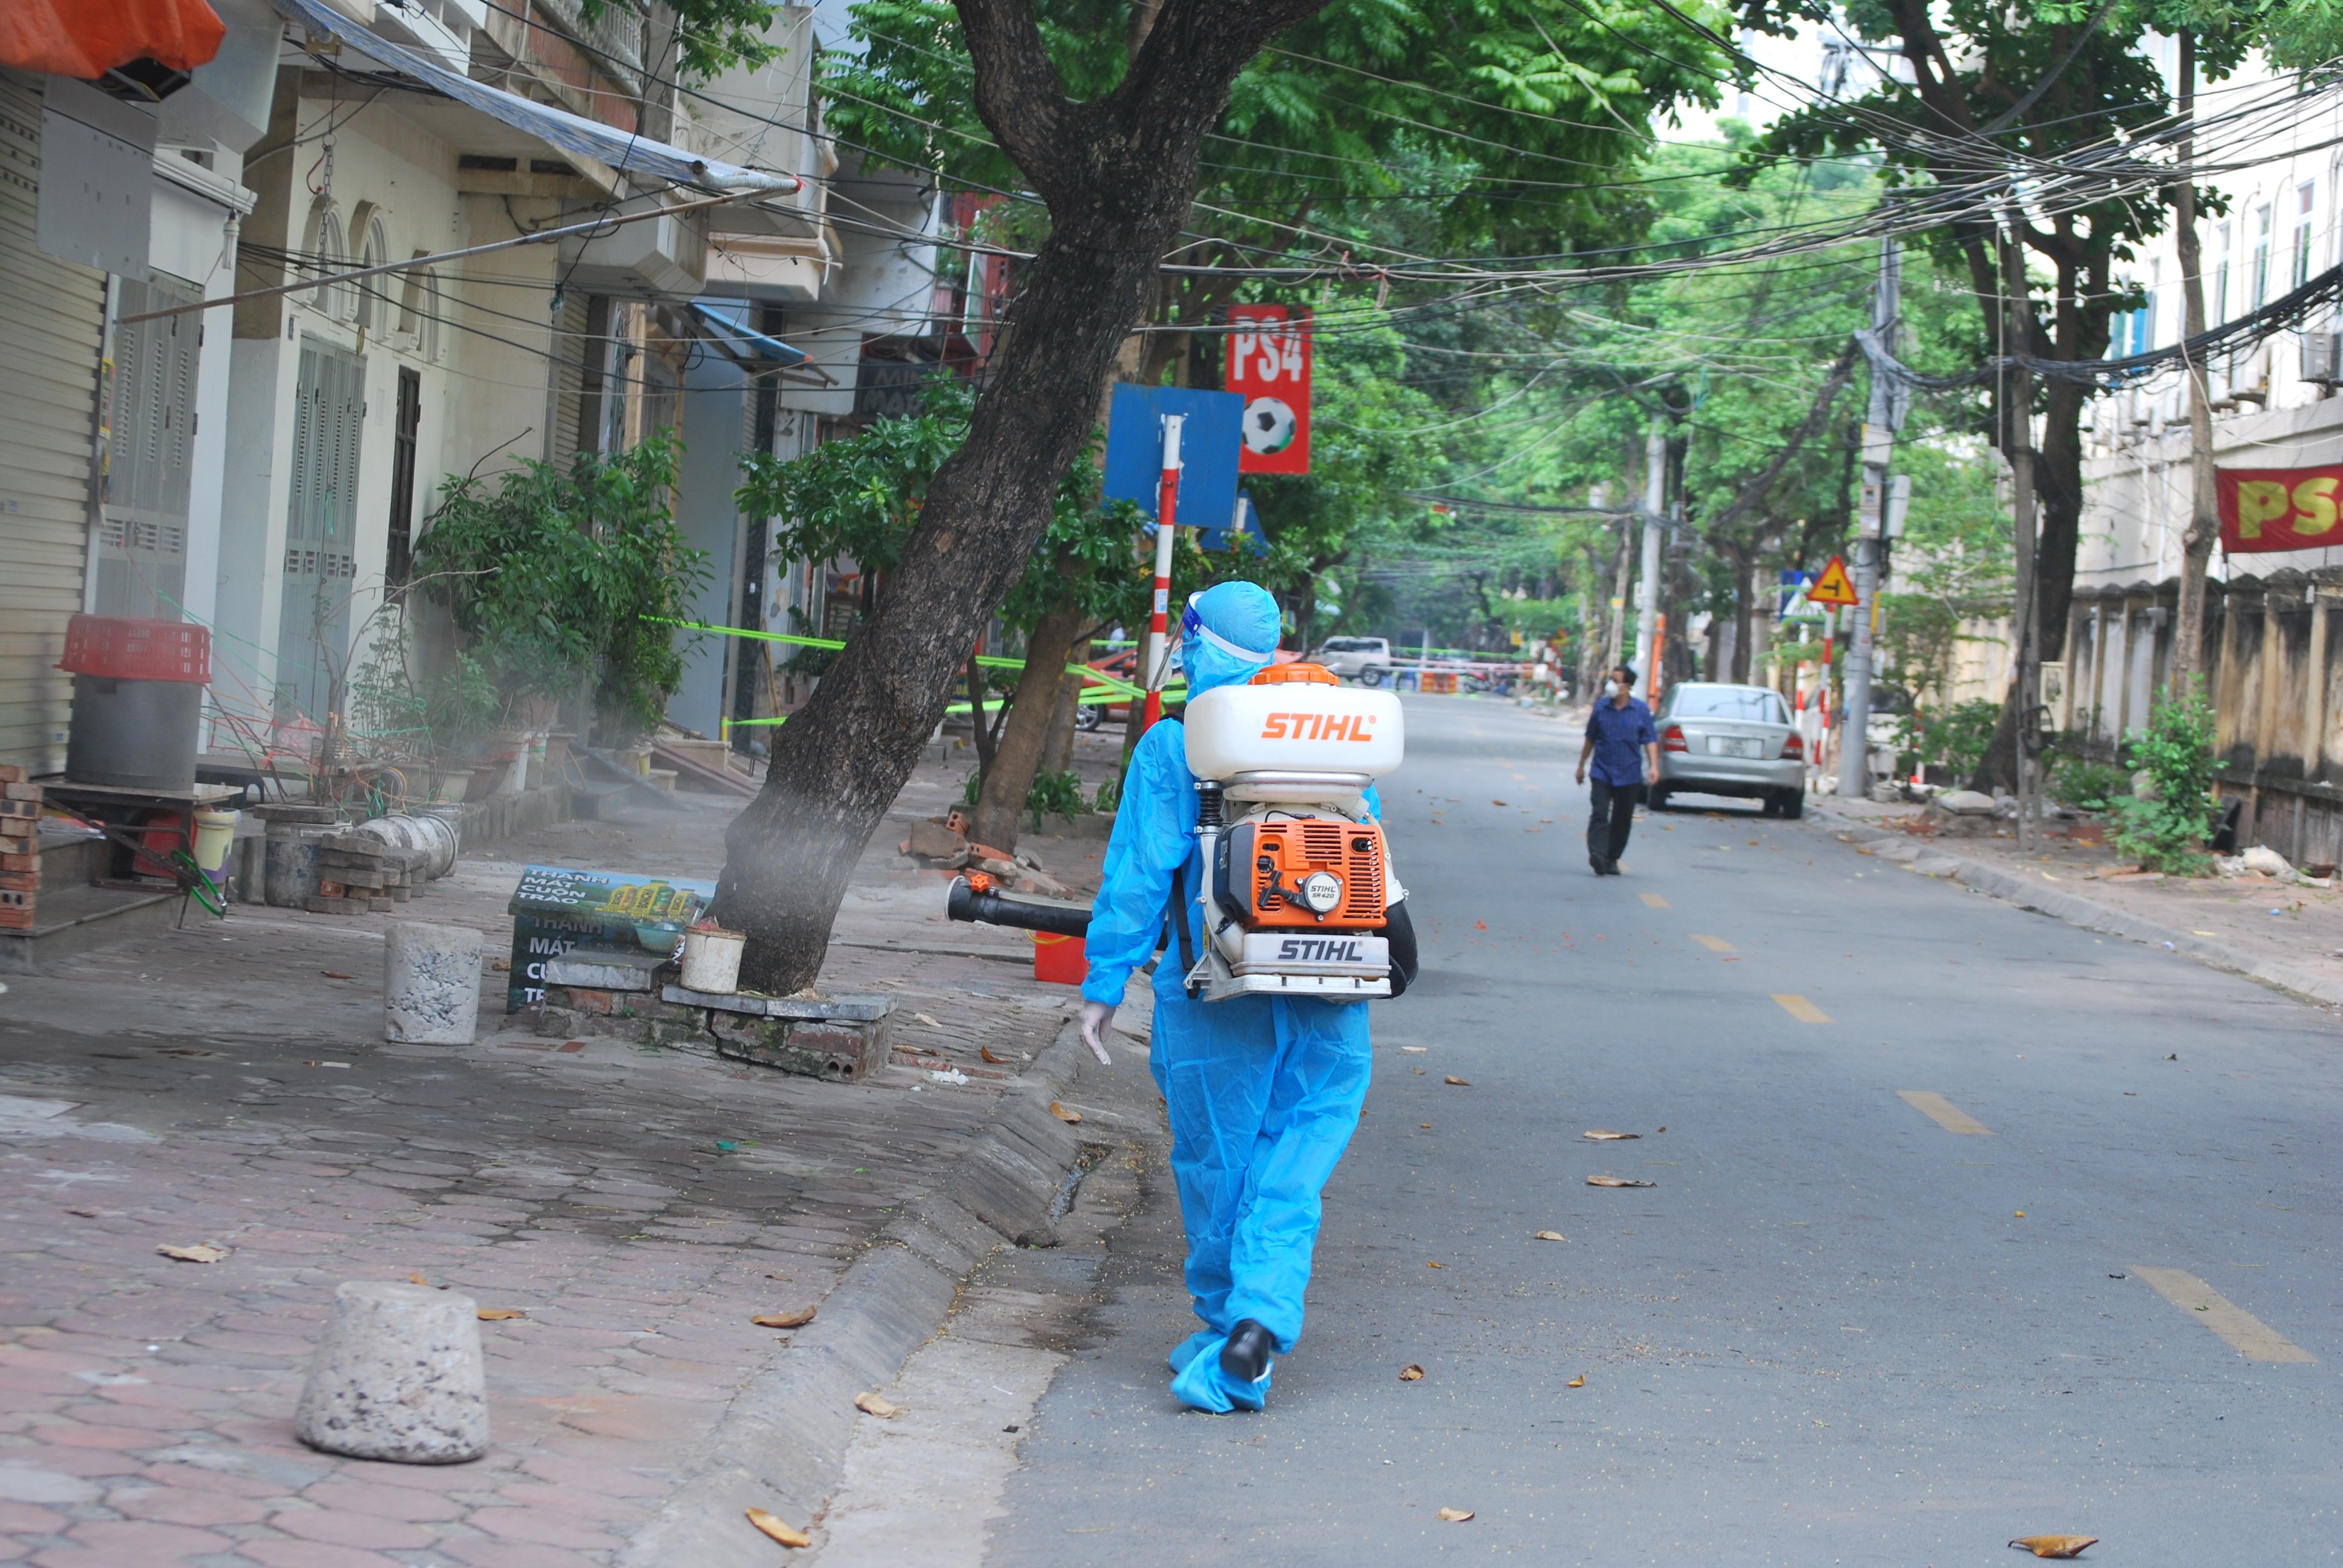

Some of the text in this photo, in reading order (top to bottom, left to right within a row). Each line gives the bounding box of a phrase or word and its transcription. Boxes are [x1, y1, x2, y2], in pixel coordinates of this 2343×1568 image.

[1234, 316, 1303, 382] PS4
[2238, 477, 2343, 537] PS
[1261, 713, 1372, 742] STIHL
[525, 877, 575, 888] MÁT
[529, 869, 609, 884] THANH
[517, 892, 579, 904] TRÀO
[521, 885, 586, 898] CUỘN
[529, 935, 575, 955] MÁT
[1278, 940, 1363, 961] STIHL
